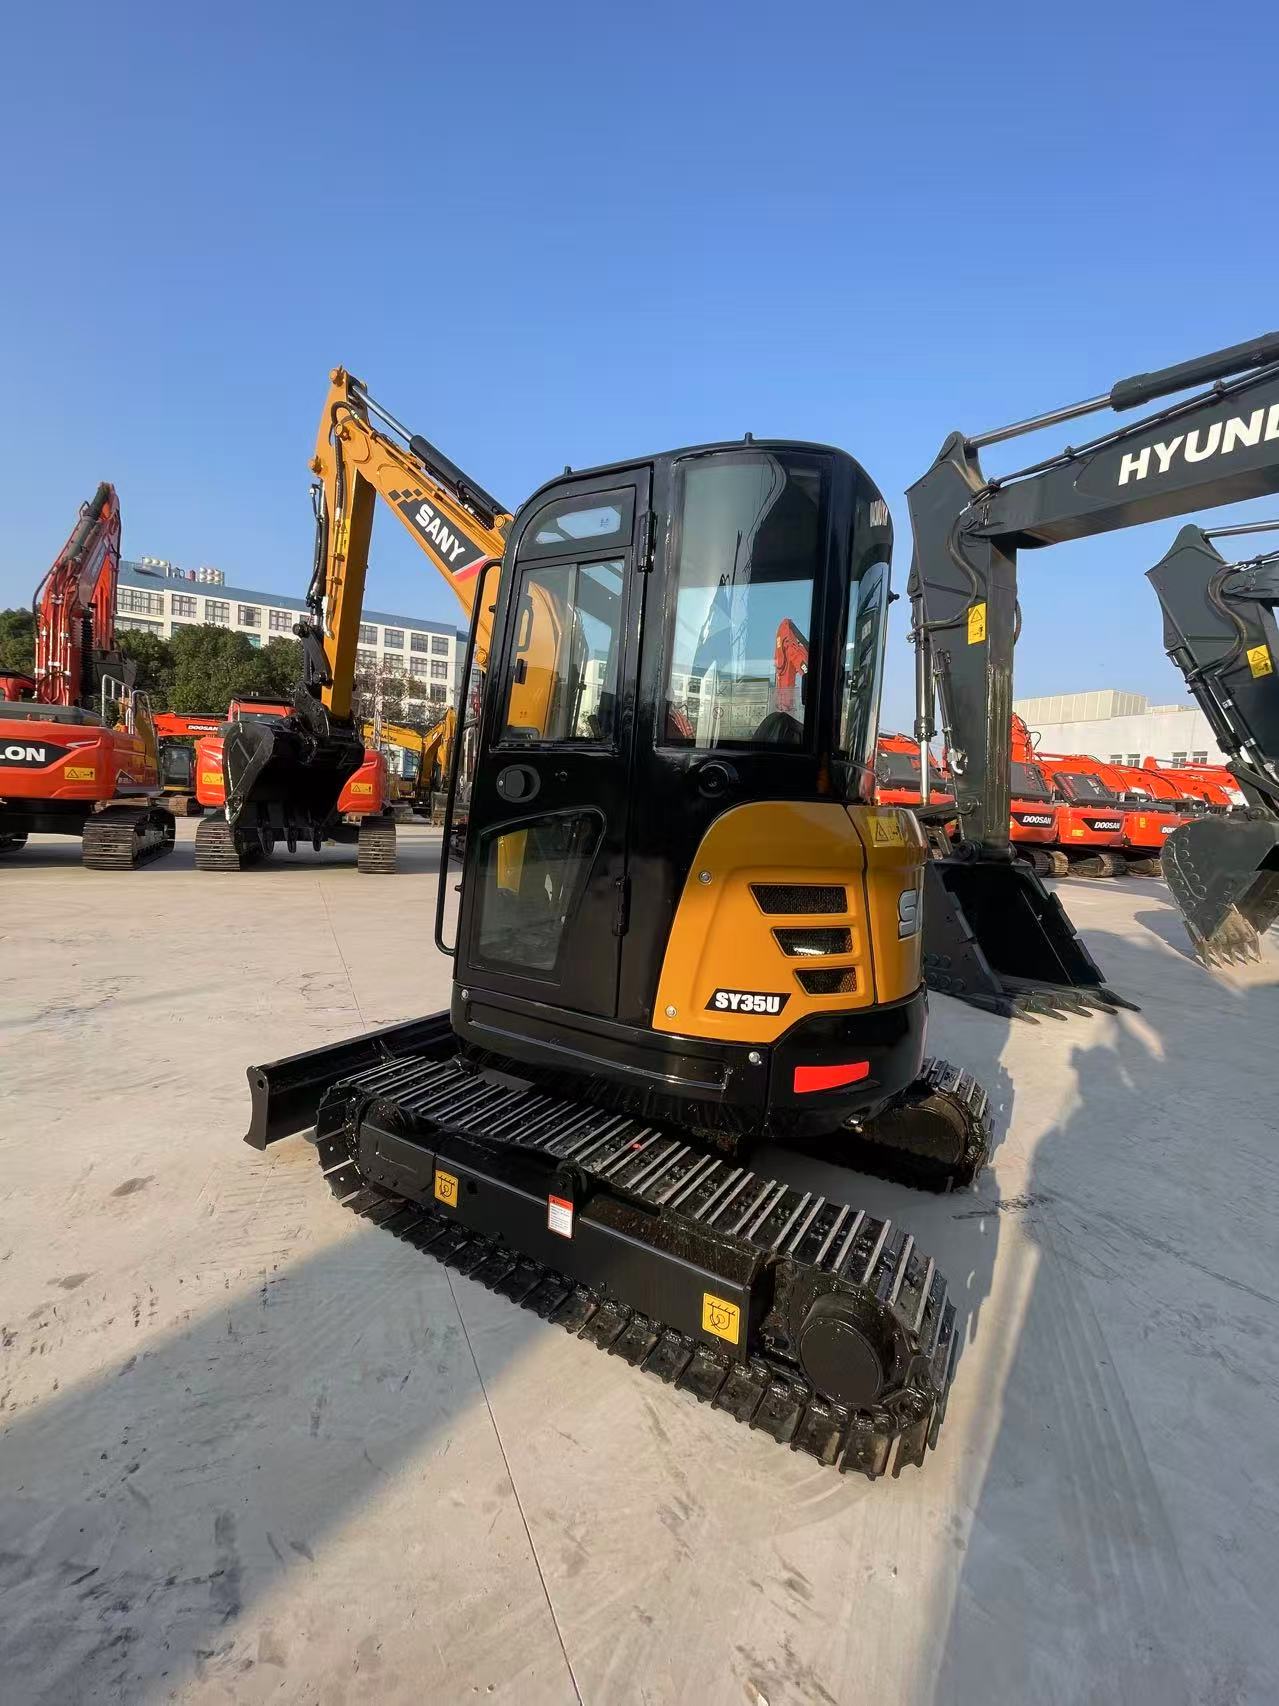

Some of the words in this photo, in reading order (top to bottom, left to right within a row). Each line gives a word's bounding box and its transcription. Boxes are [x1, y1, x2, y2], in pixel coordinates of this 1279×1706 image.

[415, 503, 466, 562] SANY
[1022, 815, 1052, 825] DOOSAN
[1094, 821, 1121, 829] DOOSAN
[715, 991, 780, 1013] SY35U
